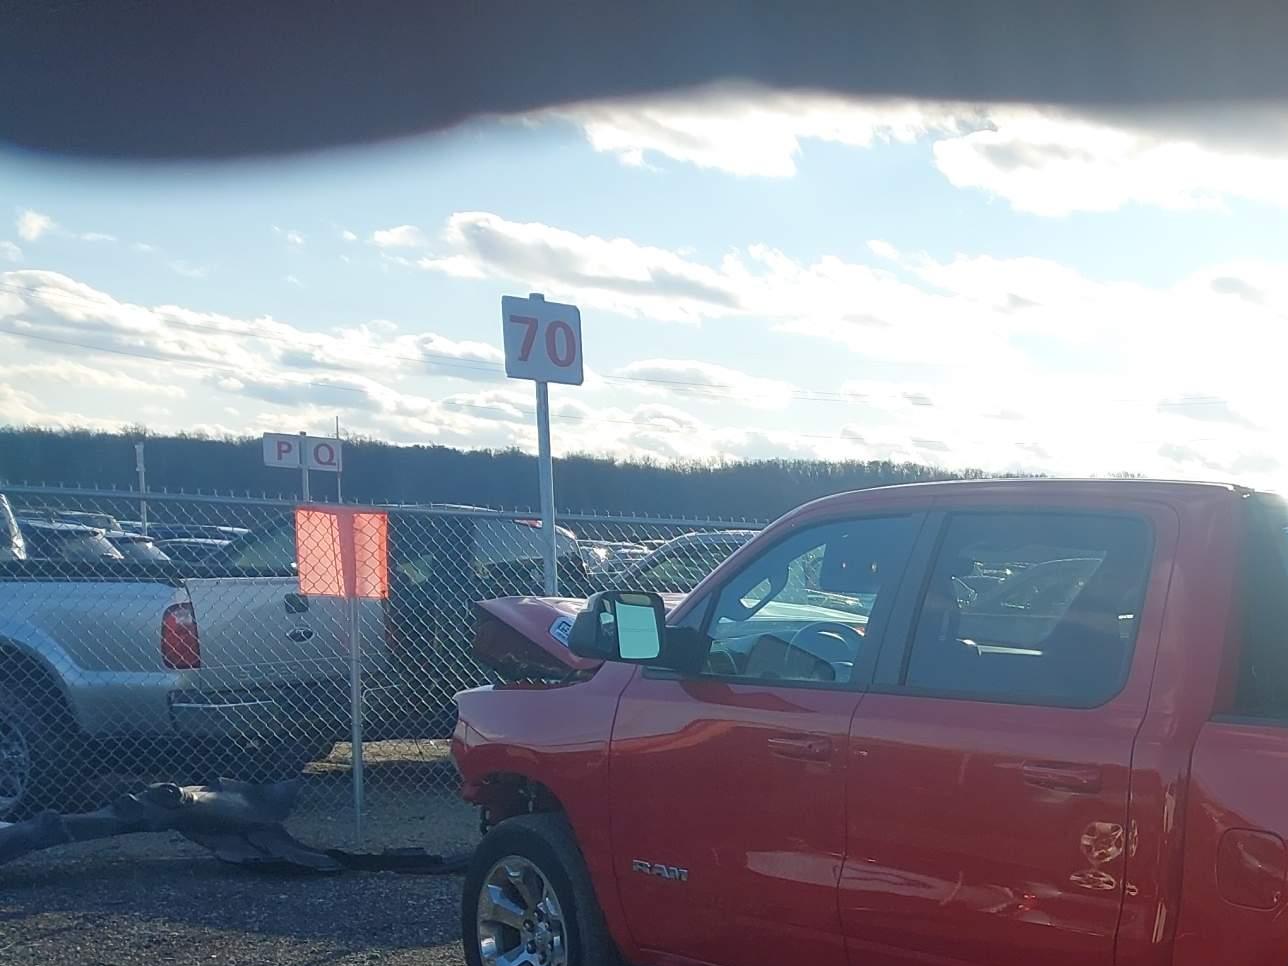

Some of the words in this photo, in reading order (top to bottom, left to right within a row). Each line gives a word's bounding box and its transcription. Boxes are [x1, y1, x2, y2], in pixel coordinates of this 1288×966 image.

[509, 313, 577, 368] 70
[276, 440, 293, 461] P
[313, 442, 337, 467] Q
[632, 858, 688, 881] RAM
